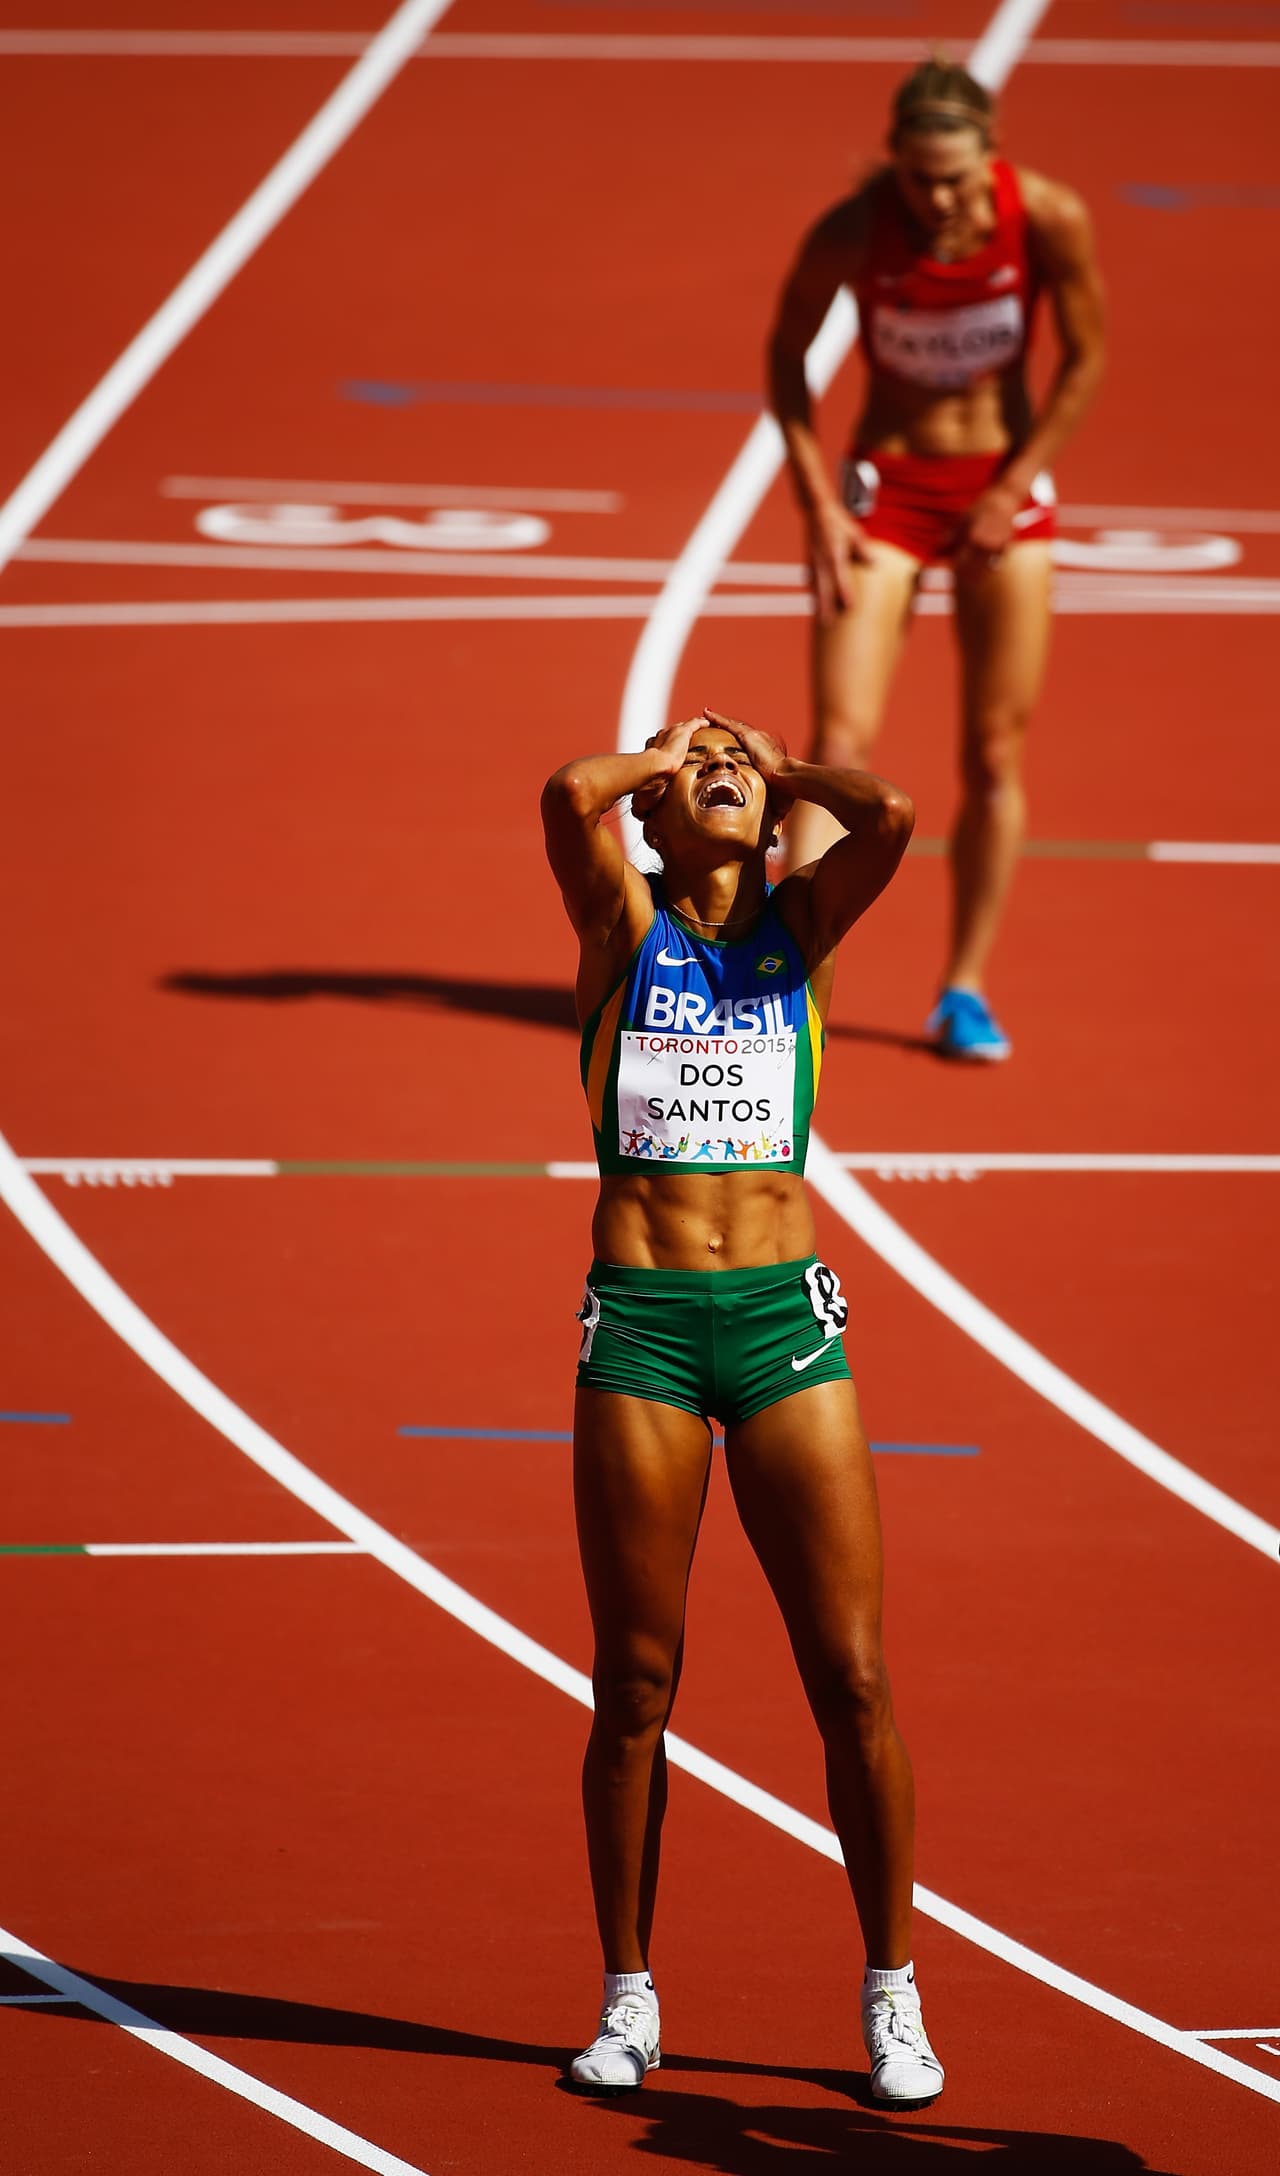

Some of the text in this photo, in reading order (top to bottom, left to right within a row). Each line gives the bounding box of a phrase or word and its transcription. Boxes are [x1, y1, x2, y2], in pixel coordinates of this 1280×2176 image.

[644, 985, 794, 1035] BRASIL
[636, 1036, 786, 1054] TORONTO 2015
[680, 1063, 744, 1087] DOS
[646, 1097, 771, 1122] SANTOS
